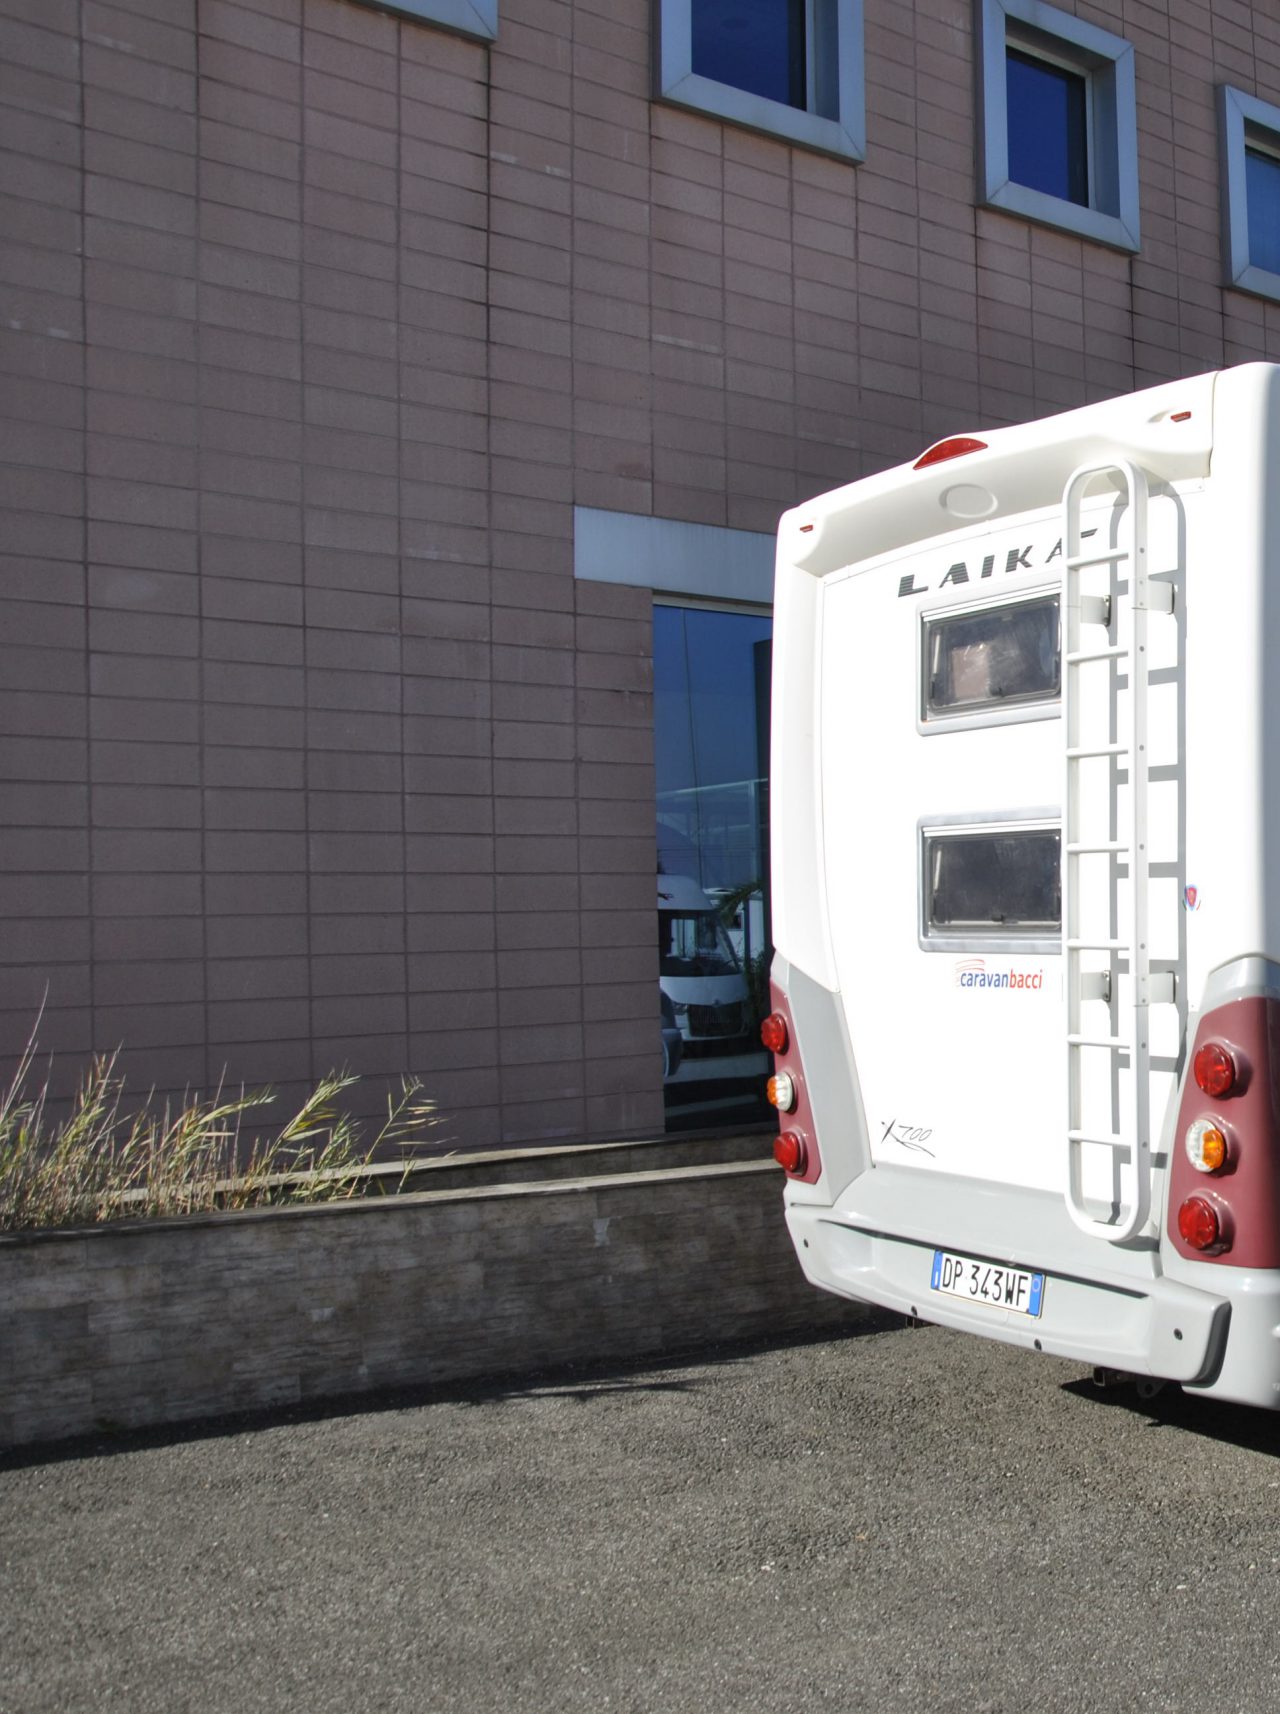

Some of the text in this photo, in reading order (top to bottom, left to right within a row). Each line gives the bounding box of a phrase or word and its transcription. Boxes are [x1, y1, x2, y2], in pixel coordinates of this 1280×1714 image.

[960, 968, 1043, 989] caravanbacci
[881, 1118, 936, 1158] X700
[969, 1264, 1029, 1307] 343WF
